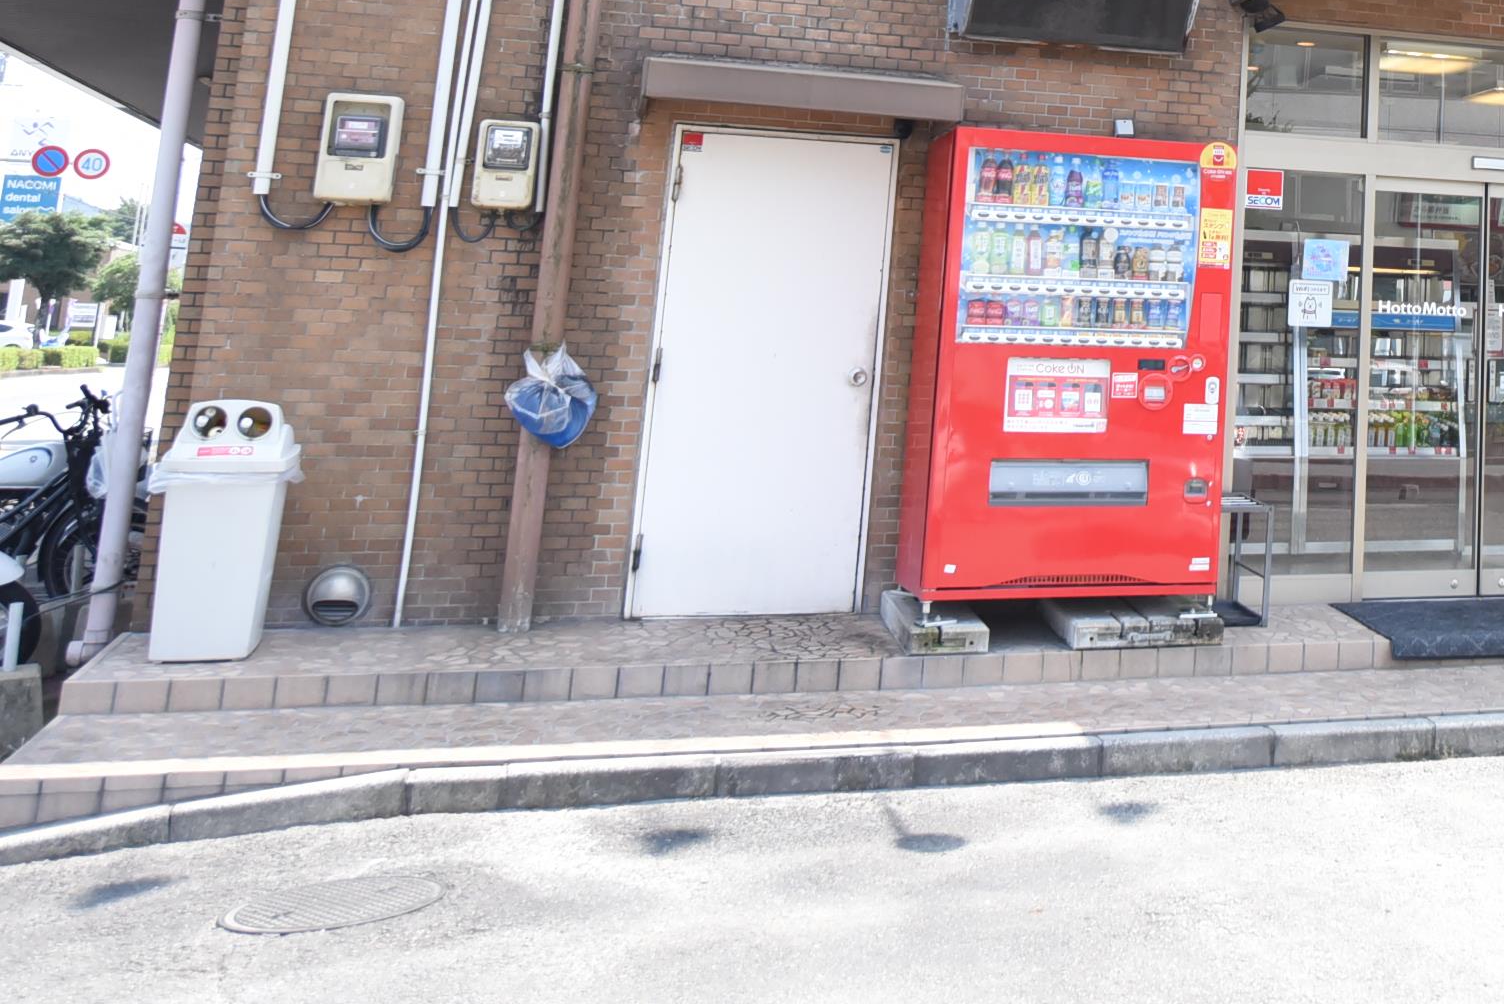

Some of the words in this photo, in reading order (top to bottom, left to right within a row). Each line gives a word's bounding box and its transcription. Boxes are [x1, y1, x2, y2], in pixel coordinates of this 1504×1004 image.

[81, 157, 103, 171] 40
[5, 192, 41, 203] dental
[1247, 196, 1280, 206] SECOM
[1035, 363, 1065, 374] Coke
